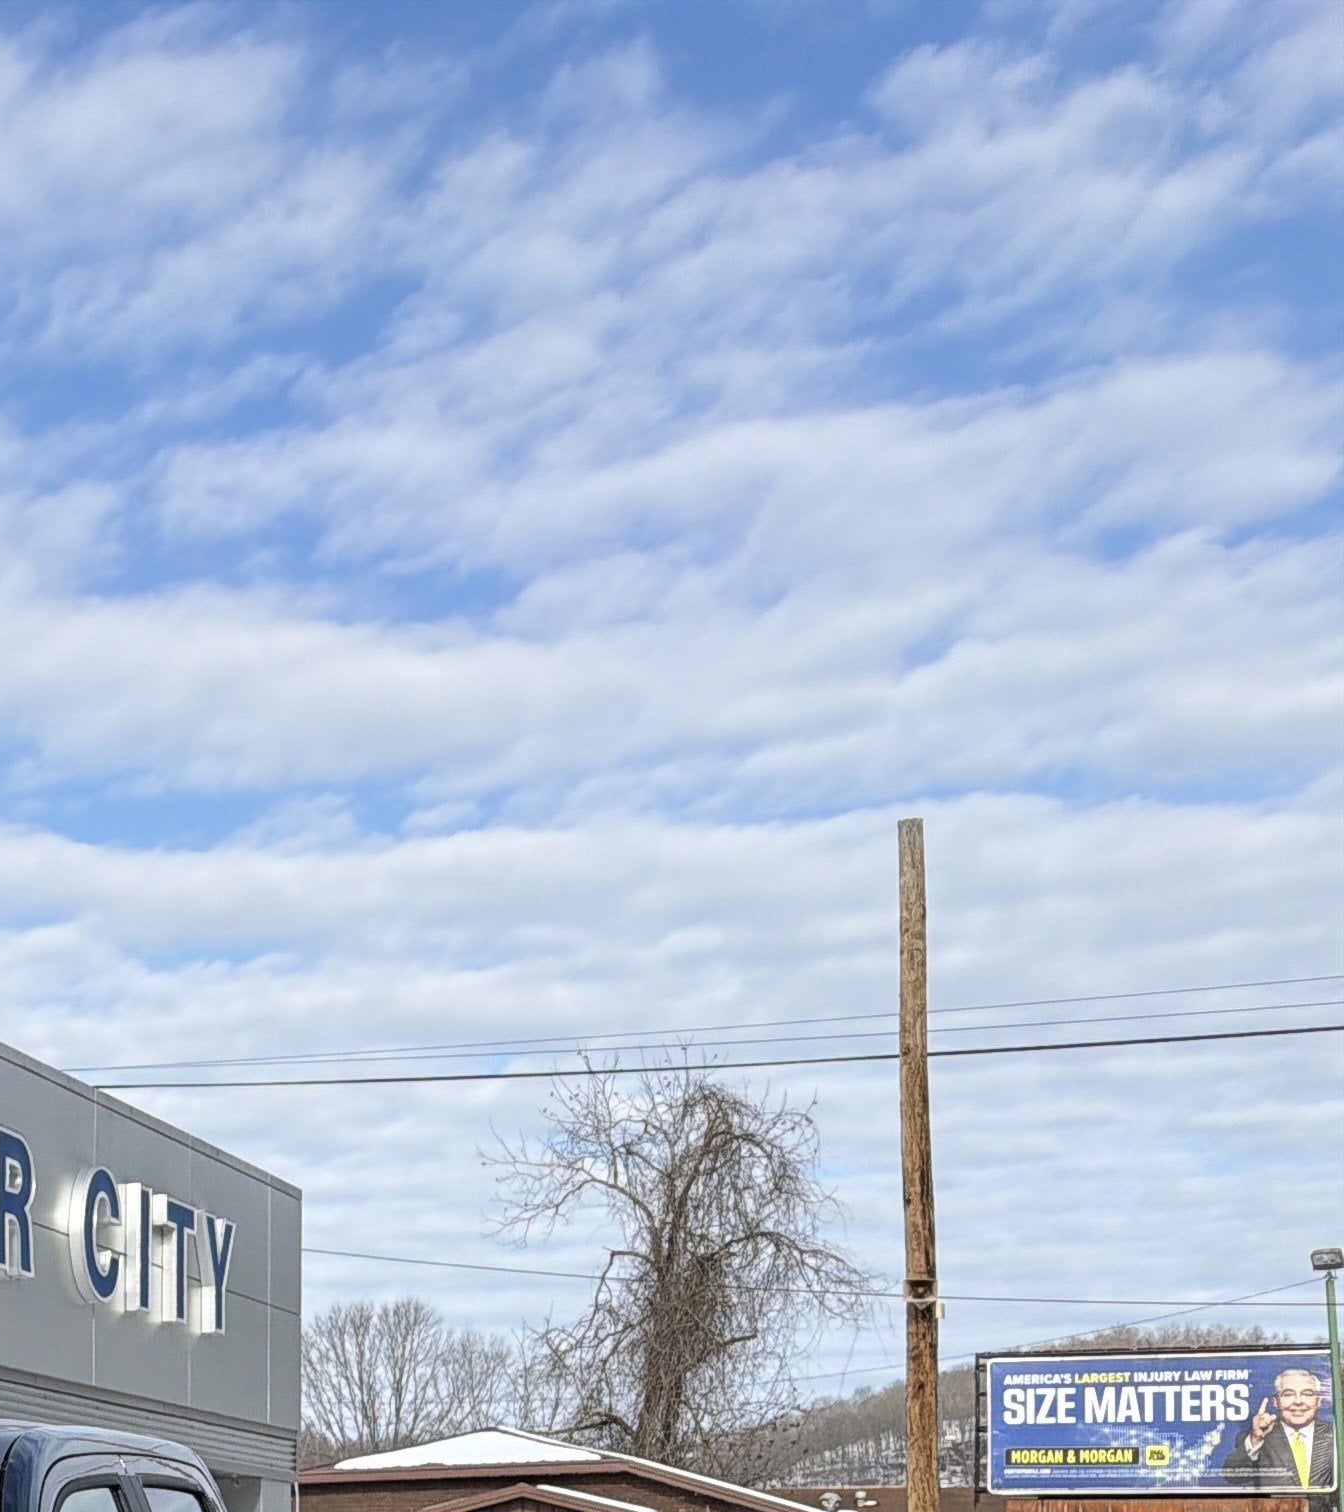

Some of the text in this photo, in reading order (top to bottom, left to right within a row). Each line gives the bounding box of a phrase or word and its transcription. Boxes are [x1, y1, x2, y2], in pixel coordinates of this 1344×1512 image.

[69, 1166, 236, 1335] CITY
[1003, 1369, 1249, 1386] AMERICA'S LARGEST INJURY LAW FIRM
[1003, 1384, 1250, 1425] SIZE MATTERS
[1011, 1449, 1064, 1464] MORGAN
[1066, 1449, 1077, 1464] &
[1079, 1448, 1134, 1463] MORGAN
